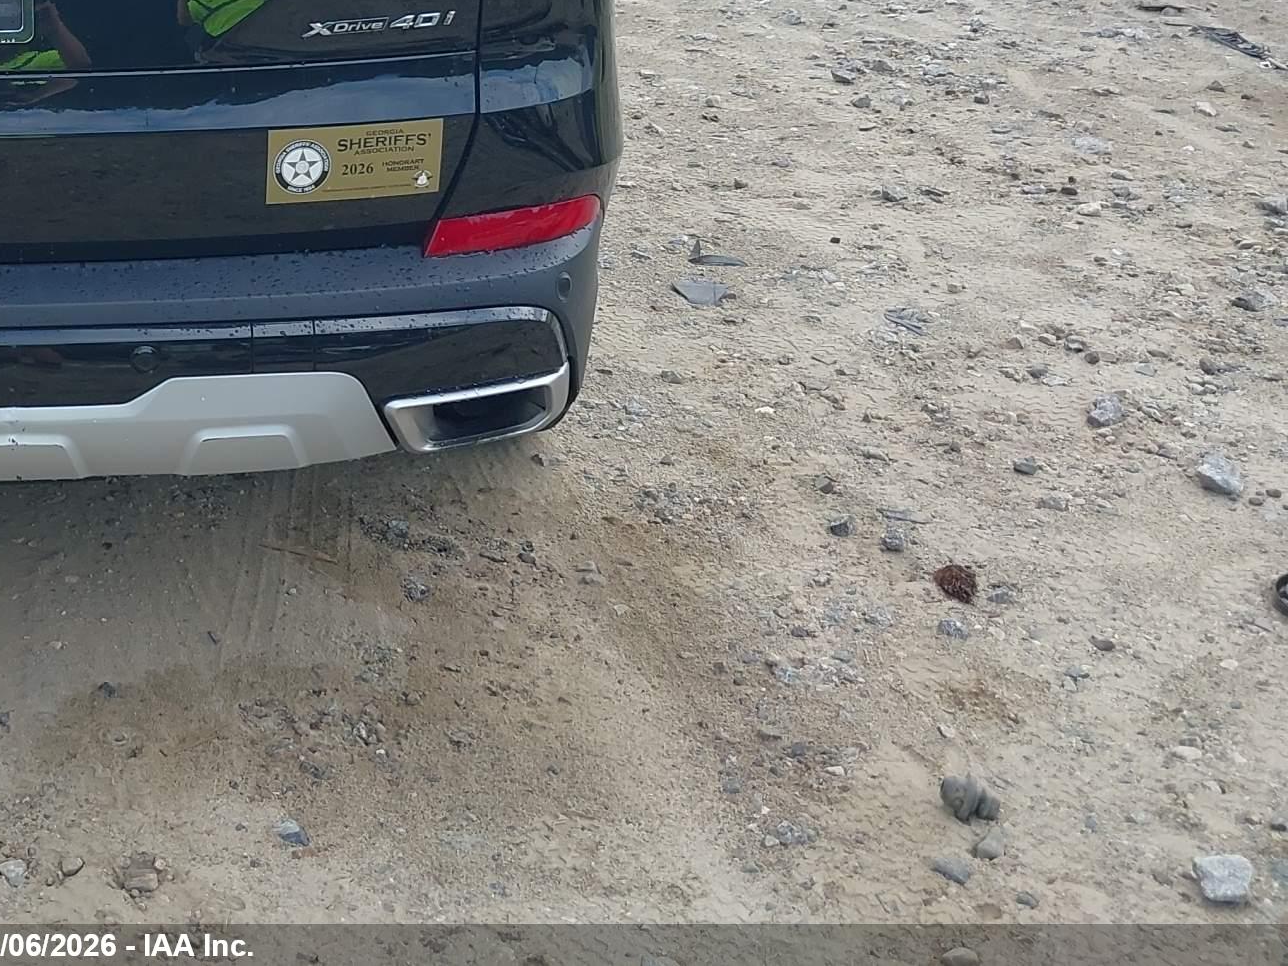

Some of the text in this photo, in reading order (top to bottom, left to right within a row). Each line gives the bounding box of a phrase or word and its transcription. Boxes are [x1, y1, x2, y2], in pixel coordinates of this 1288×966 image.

[366, 128, 404, 137] GEORGIA
[337, 132, 432, 153] SHERIFFS'
[353, 146, 415, 156] ASSOCIATION
[341, 162, 374, 176] 2026
